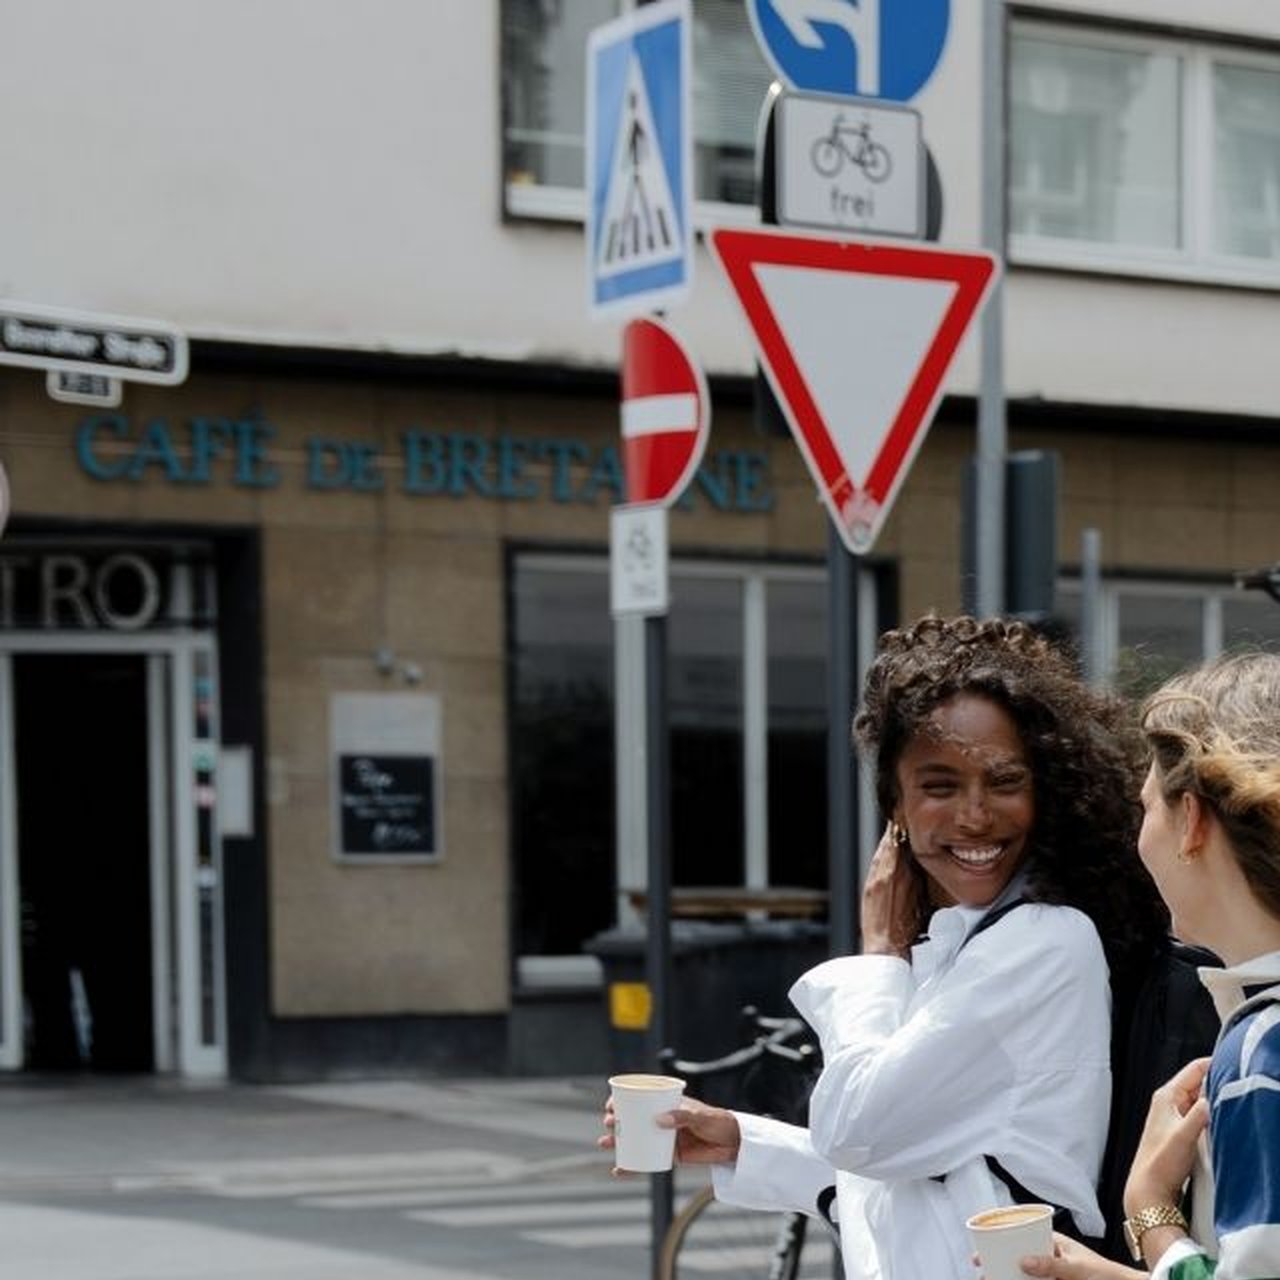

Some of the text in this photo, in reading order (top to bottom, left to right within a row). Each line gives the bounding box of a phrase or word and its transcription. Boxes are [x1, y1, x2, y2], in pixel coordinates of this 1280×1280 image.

[829, 184, 876, 218] frei
[76, 404, 776, 514] CAFÉ DE BRETANE
